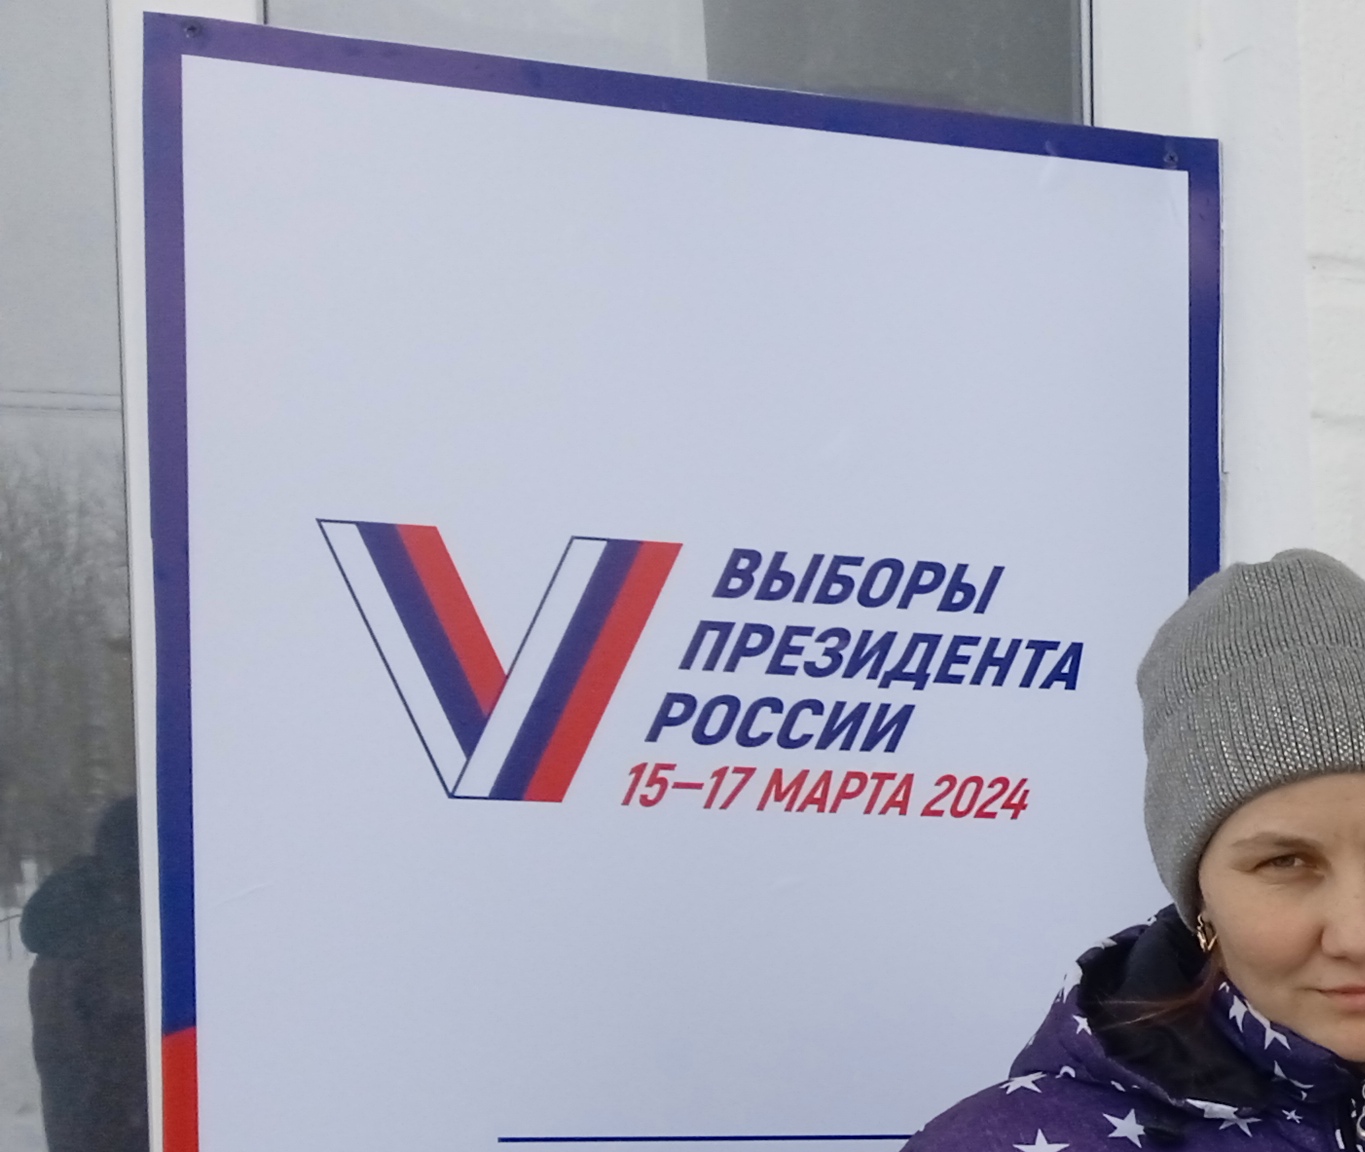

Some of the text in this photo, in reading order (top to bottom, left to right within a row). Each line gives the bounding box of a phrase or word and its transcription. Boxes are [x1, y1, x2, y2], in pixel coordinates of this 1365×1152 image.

[711, 548, 1005, 614] ВЫБОРЫ
[678, 620, 1084, 690] ПРЕЗИДЕНТА
[644, 692, 915, 753] РОССИИ
[757, 768, 915, 816] МАРТА
[921, 774, 1030, 820] 2024
